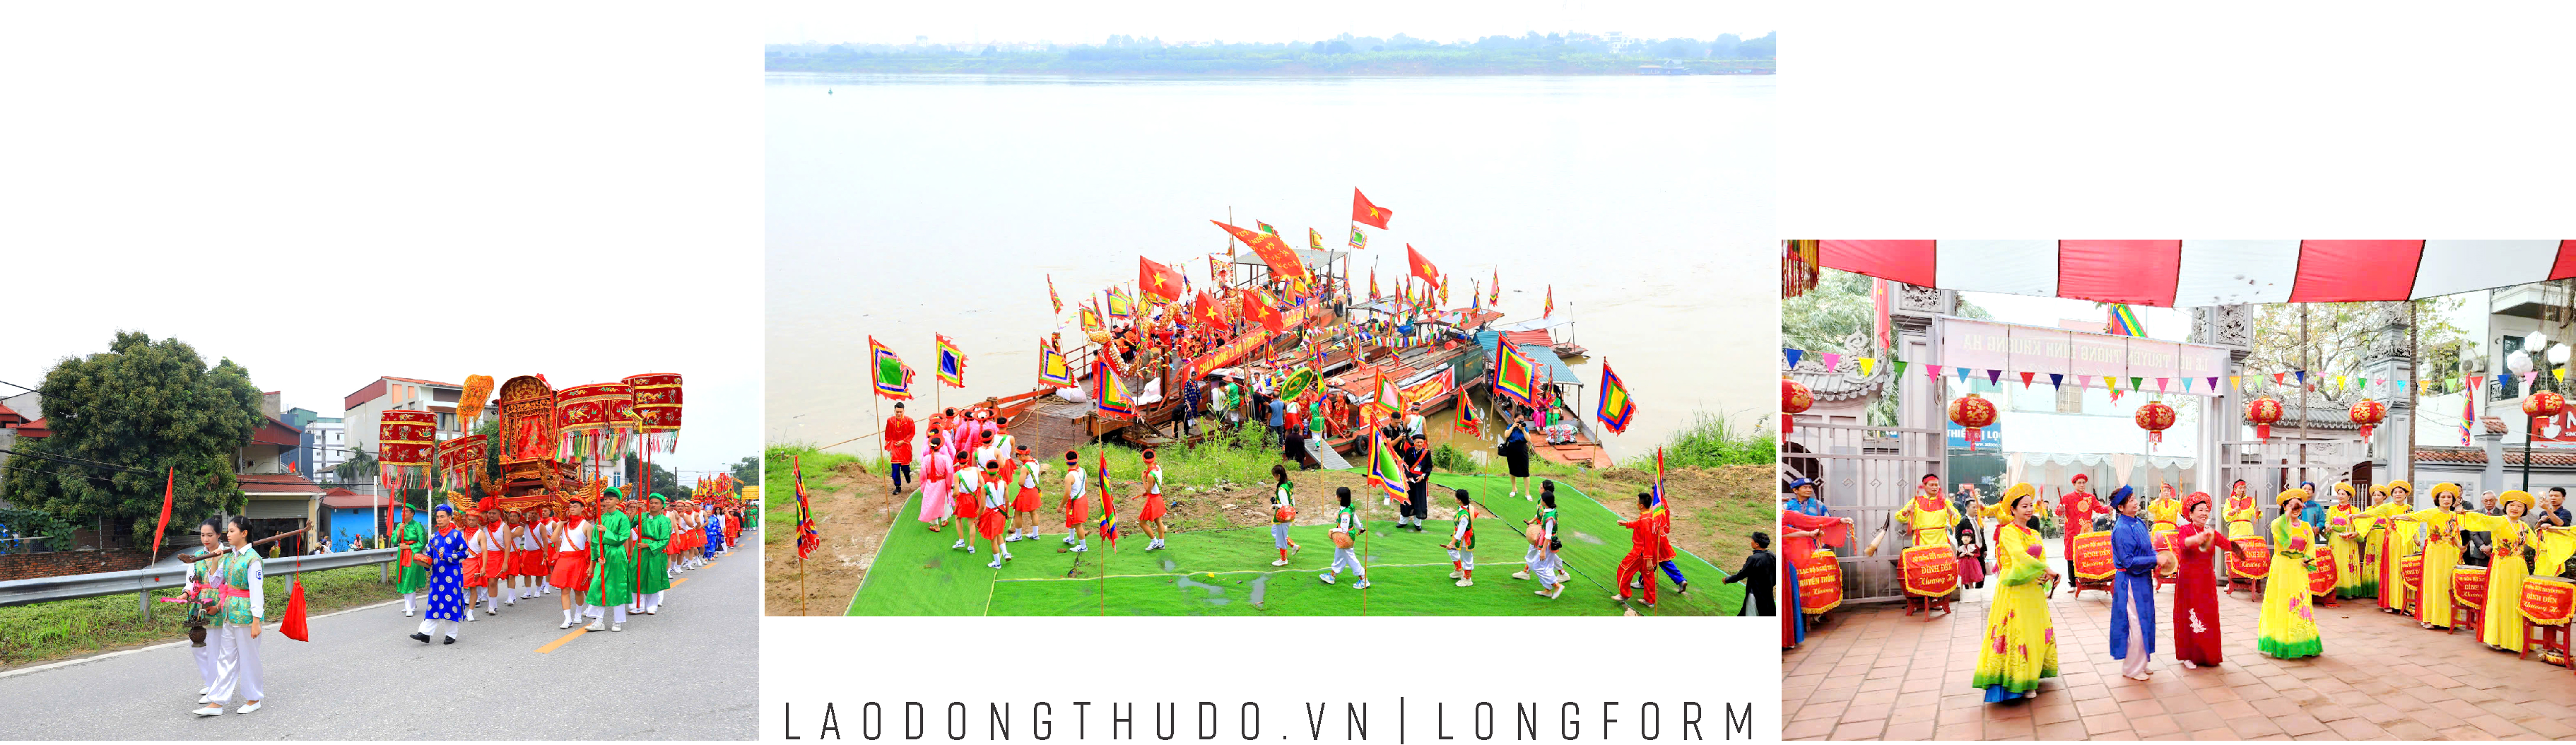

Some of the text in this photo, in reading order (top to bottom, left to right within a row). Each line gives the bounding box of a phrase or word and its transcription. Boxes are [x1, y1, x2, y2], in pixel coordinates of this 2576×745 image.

[1920, 563, 1941, 574] ĐÌNH
[1799, 576, 1820, 587] RUYỀN
[1919, 576, 1946, 586] Khương
[2523, 601, 2547, 612] Khương
